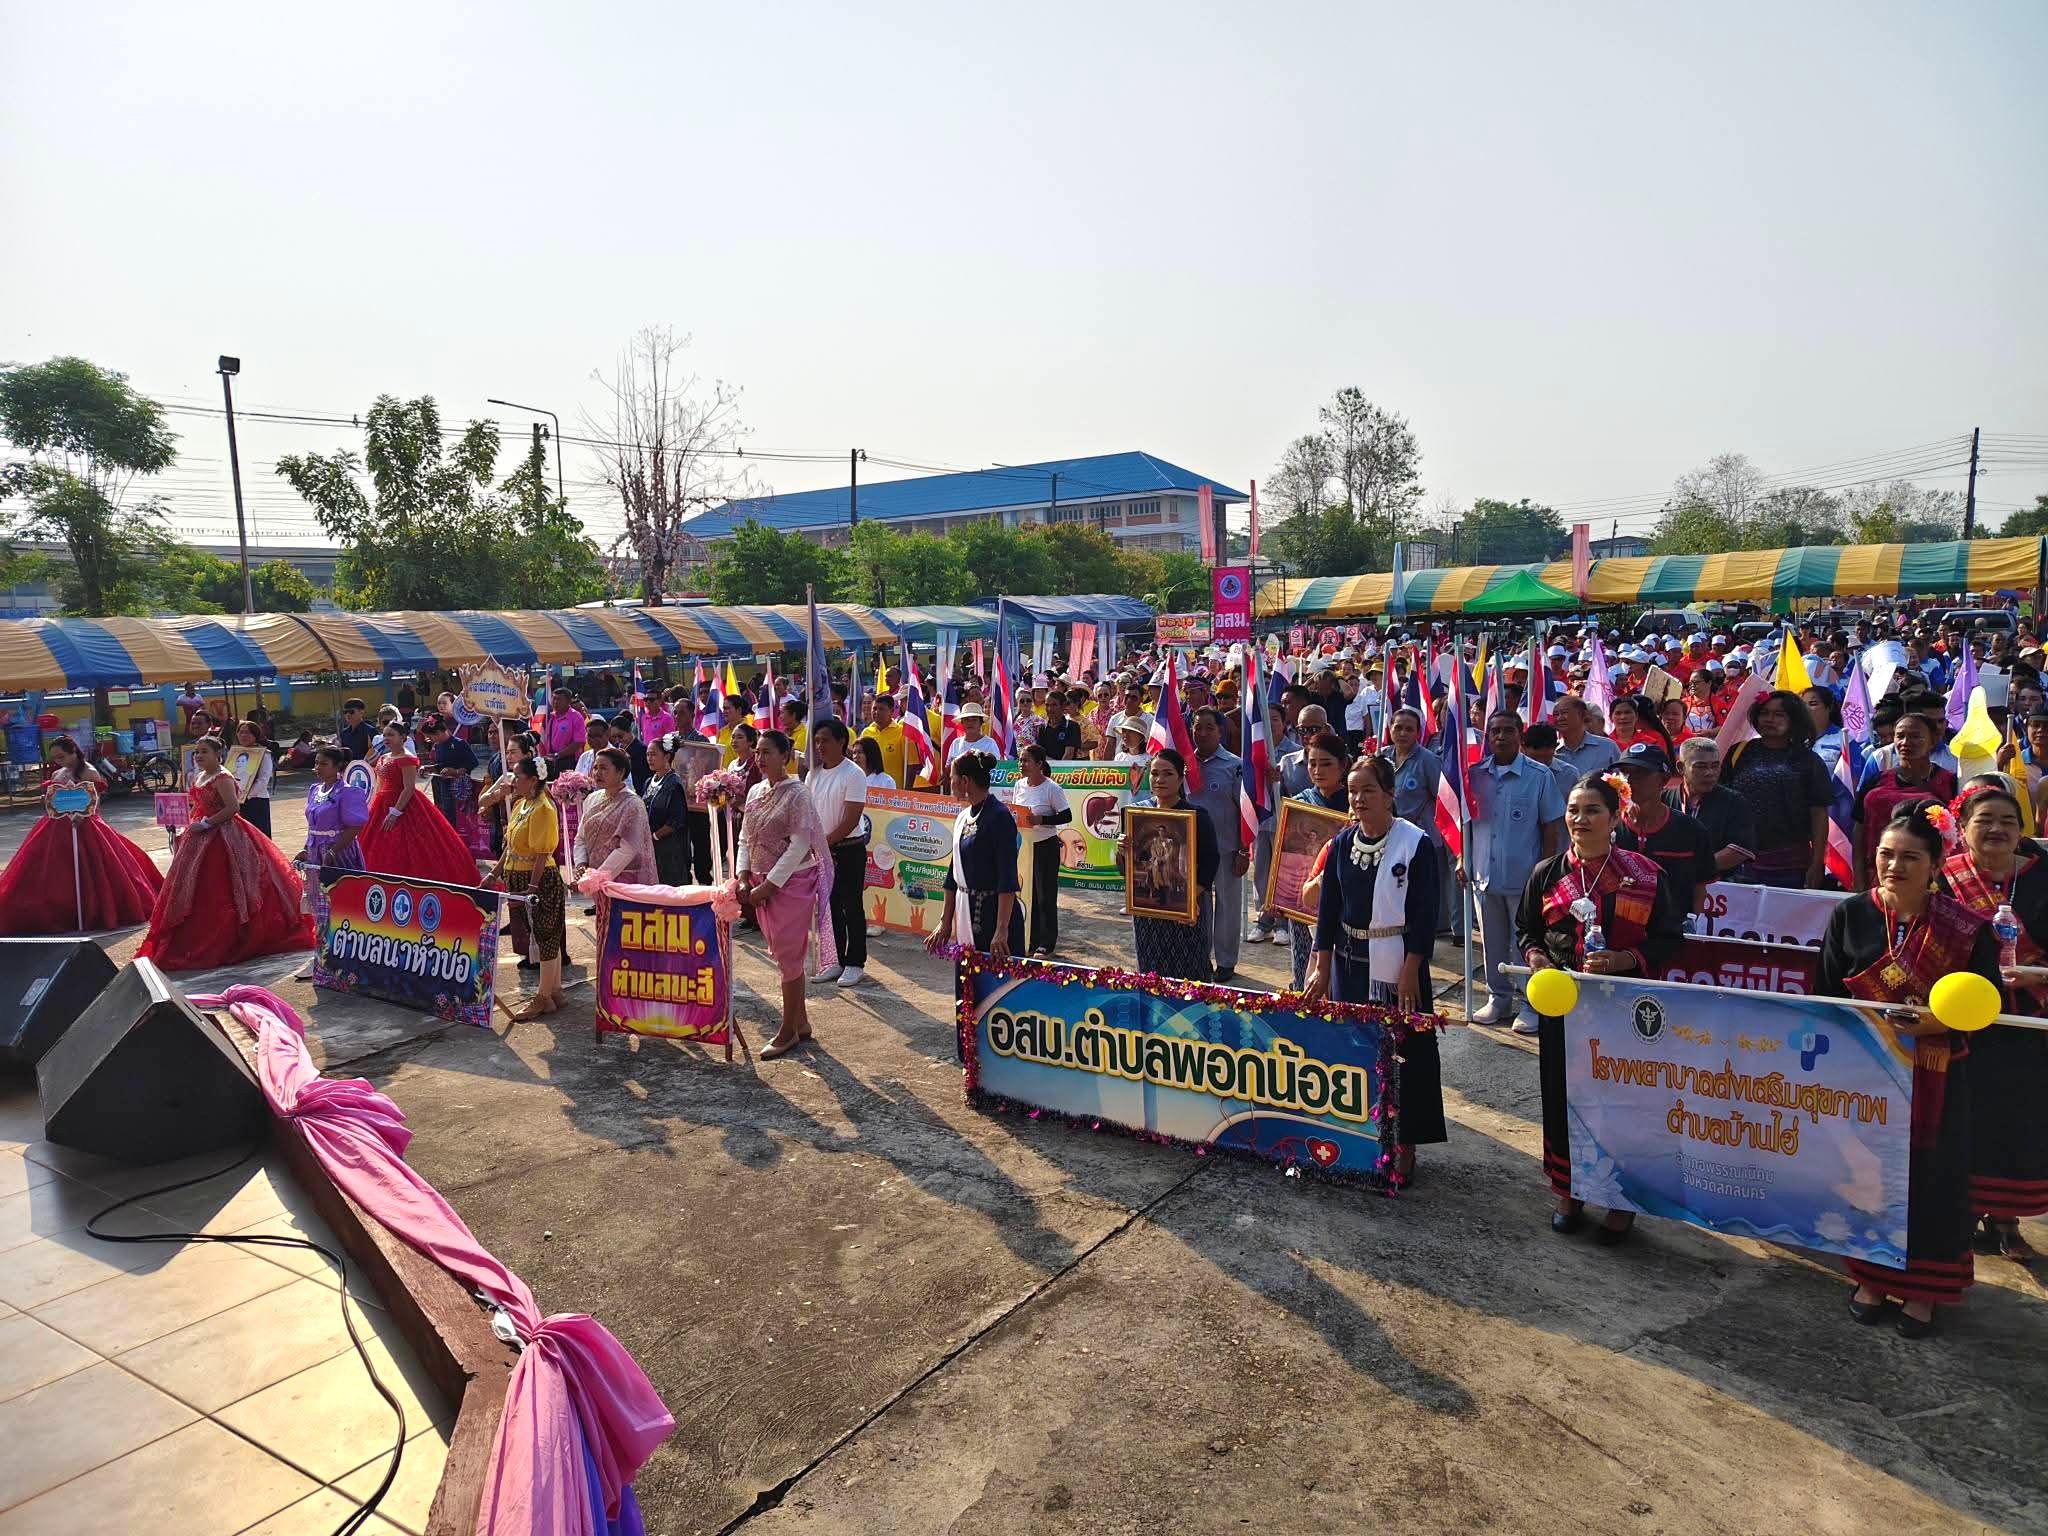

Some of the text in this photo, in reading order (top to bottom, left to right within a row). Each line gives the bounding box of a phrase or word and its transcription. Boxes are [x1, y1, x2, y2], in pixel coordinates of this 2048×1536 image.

[1215, 613, 1250, 629] อสม.
[908, 818, 930, 833] 5 ส
[333, 919, 472, 984] ตำบลนาหัวบ่อ
[989, 1010, 1367, 1119] อสม.ตำบลพอกน้อย
[1589, 1038, 1888, 1125] โรงพยาบาลส่งเสริมสุขภาพ
[1680, 1168, 1768, 1200] จังหวัดสกลนคร
